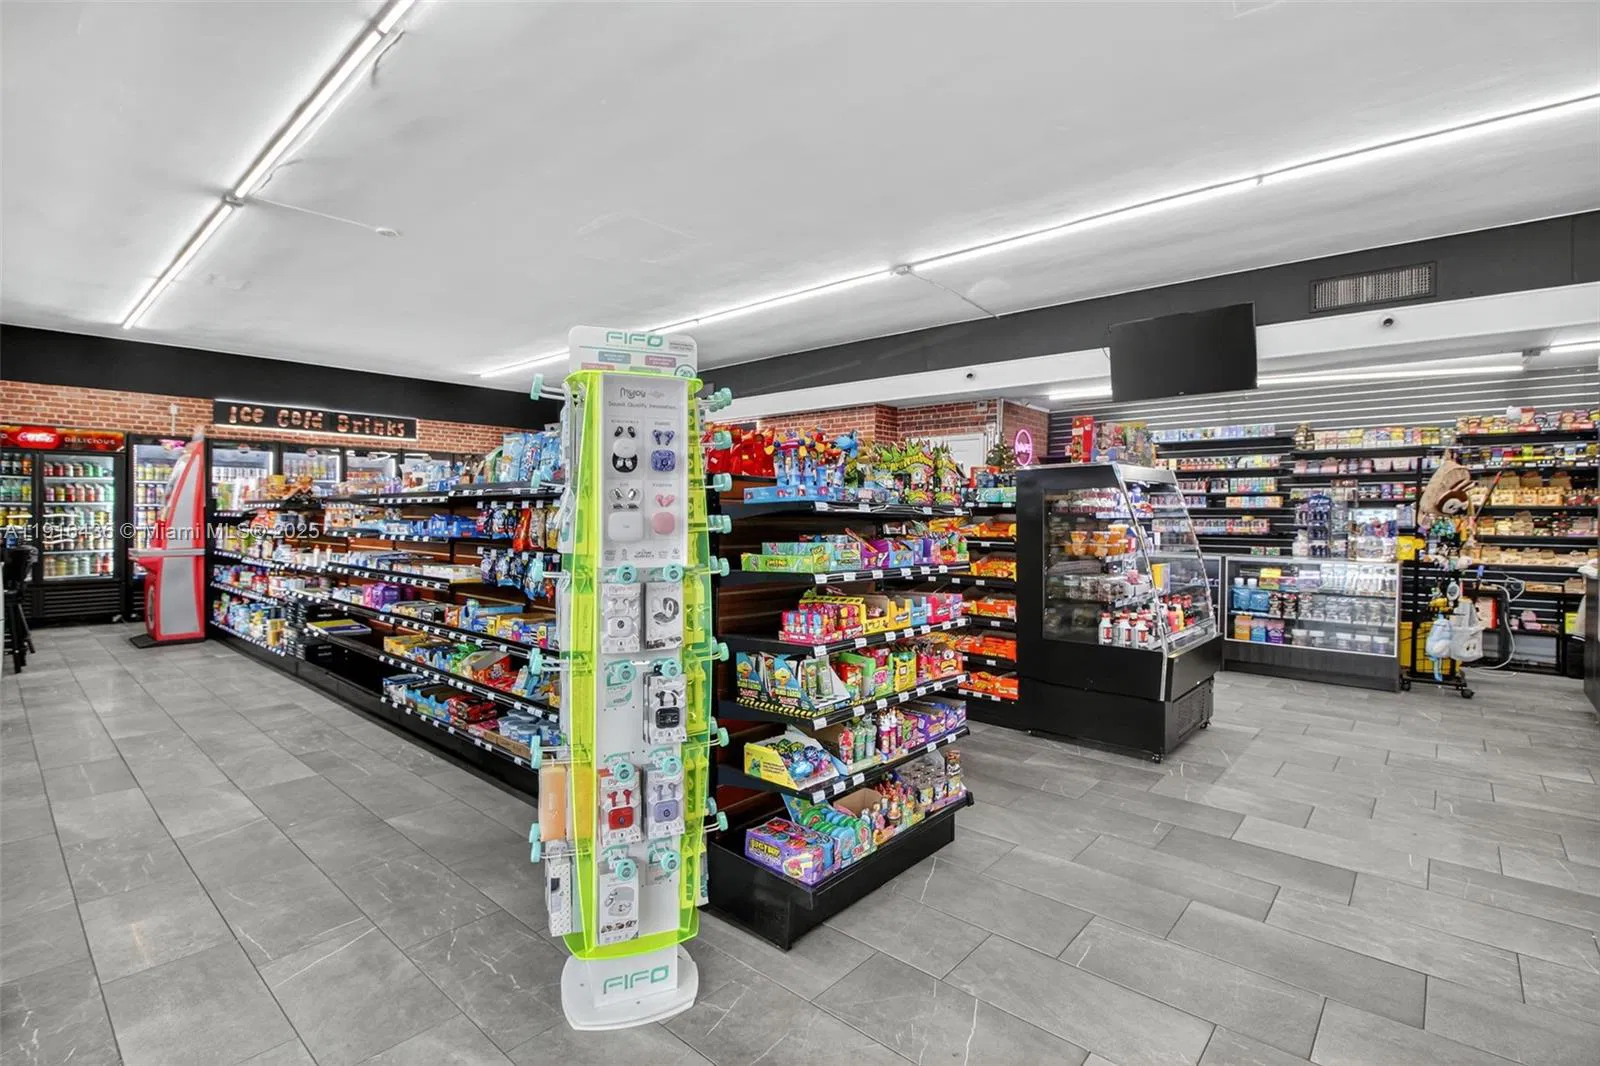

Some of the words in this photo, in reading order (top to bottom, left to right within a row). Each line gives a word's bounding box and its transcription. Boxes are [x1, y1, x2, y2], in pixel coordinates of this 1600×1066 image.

[606, 331, 663, 347] FIFO
[228, 406, 265, 424] Ice
[276, 409, 324, 429] Cold
[336, 414, 406, 437] Drinks
[64, 436, 116, 445] DELICIOUS
[603, 965, 670, 995] FIFO
